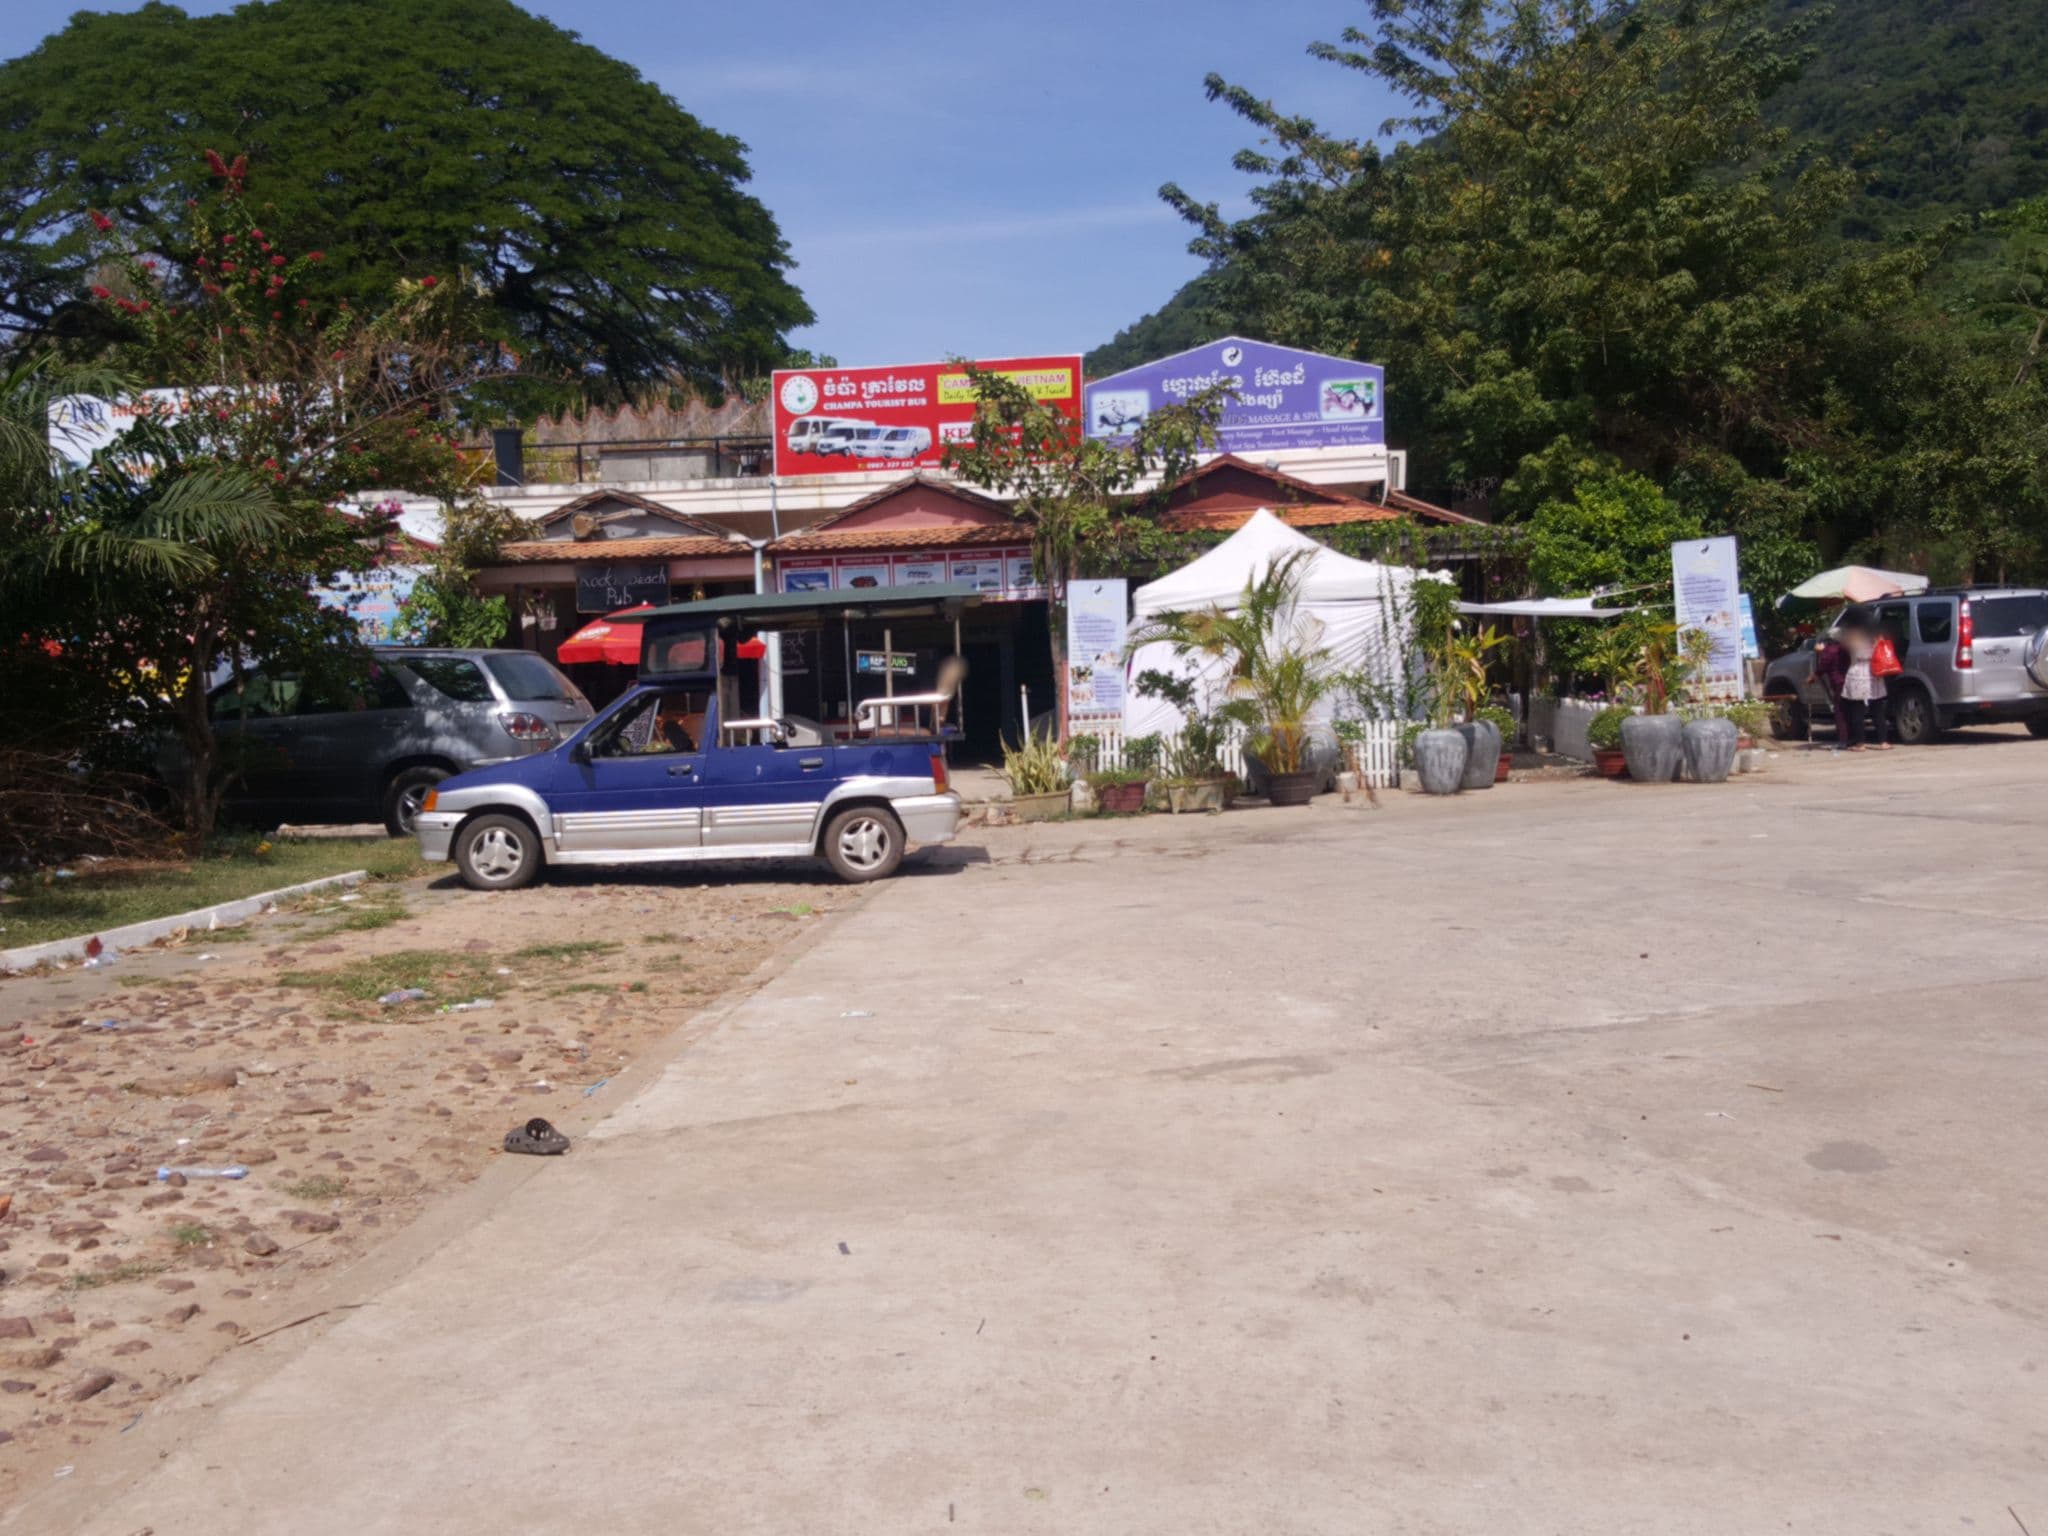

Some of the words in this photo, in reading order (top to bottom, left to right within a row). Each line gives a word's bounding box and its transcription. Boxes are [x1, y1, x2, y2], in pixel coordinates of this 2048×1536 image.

[1015, 374, 1066, 386] VIETNAM
[823, 401, 863, 411] CHAMPA
[865, 399, 906, 410] TOURIST
[907, 398, 928, 407] BUS
[1248, 412, 1292, 425] MASSAGE
[606, 585, 633, 606] Pub
